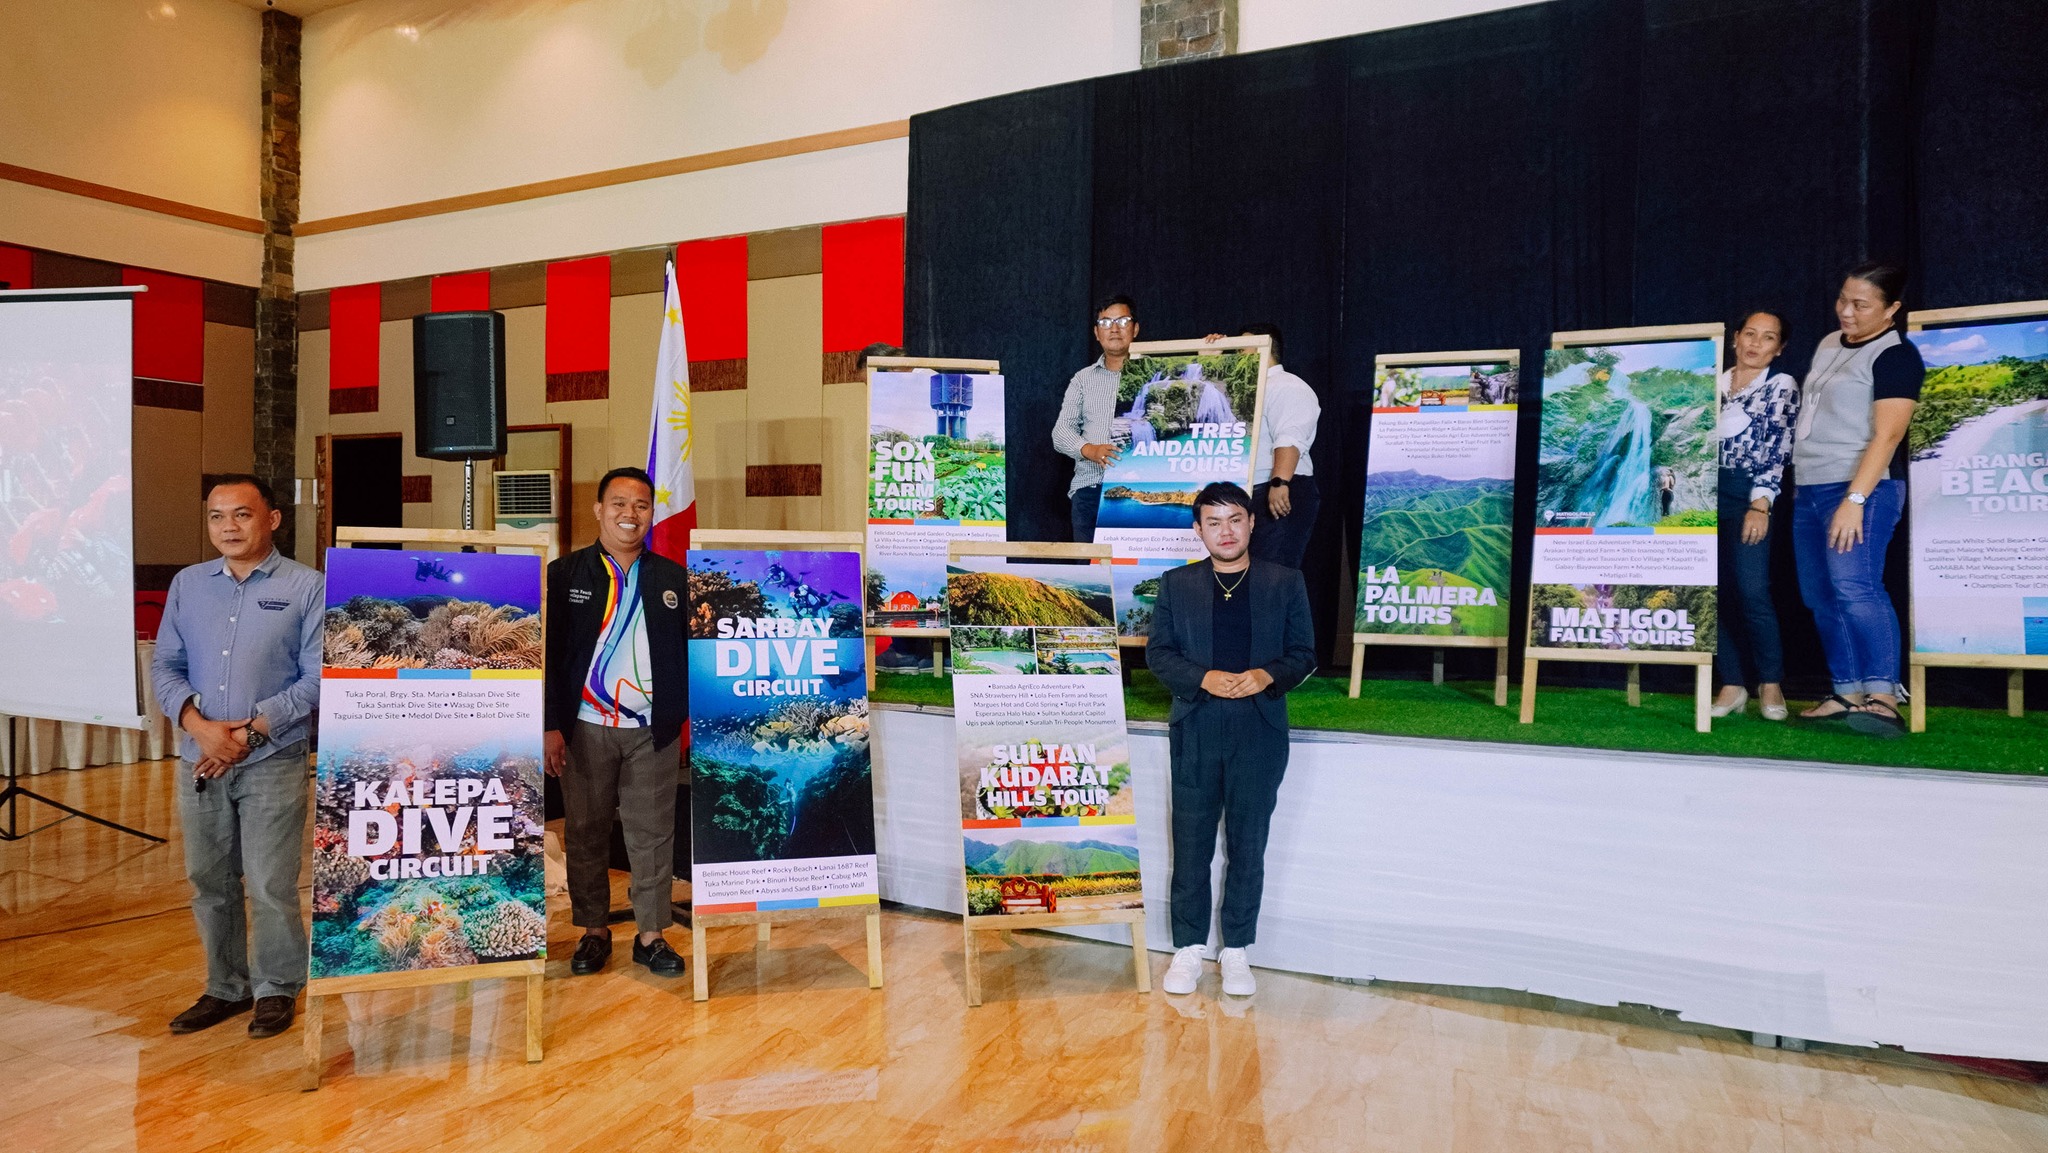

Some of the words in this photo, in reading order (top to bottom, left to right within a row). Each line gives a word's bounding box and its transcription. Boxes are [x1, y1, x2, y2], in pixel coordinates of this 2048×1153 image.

[1189, 422, 1247, 439] TRES
[875, 440, 935, 462] SOX
[1132, 439, 1245, 457] ANDANAS
[875, 461, 935, 482] FUN
[1168, 457, 1242, 473] TOURS
[875, 482, 934, 498] FARM
[874, 498, 935, 512] TOURS
[1367, 566, 1401, 584] LA
[1365, 585, 1498, 606] PALMERA
[1364, 604, 1452, 626] TOURS
[1551, 607, 1696, 630] MATIGOL
[717, 618, 835, 639] SARBAY
[1550, 627, 1614, 645] FALLS
[1619, 629, 1696, 646] TOURS
[716, 640, 840, 677] DIVE
[390, 691, 409, 699] Brgy.
[732, 678, 824, 697] CIRCUIT
[333, 713, 363, 721] Taguisa
[992, 744, 1096, 765] SULTAN
[980, 765, 1112, 788] KUDARAT
[355, 778, 511, 808] KALEPA
[987, 790, 1047, 807] HILLS
[1051, 788, 1110, 806] TOUR
[348, 805, 514, 857] DIVE
[370, 854, 494, 881] CIRCUIT
[702, 870, 728, 878] Belimac
